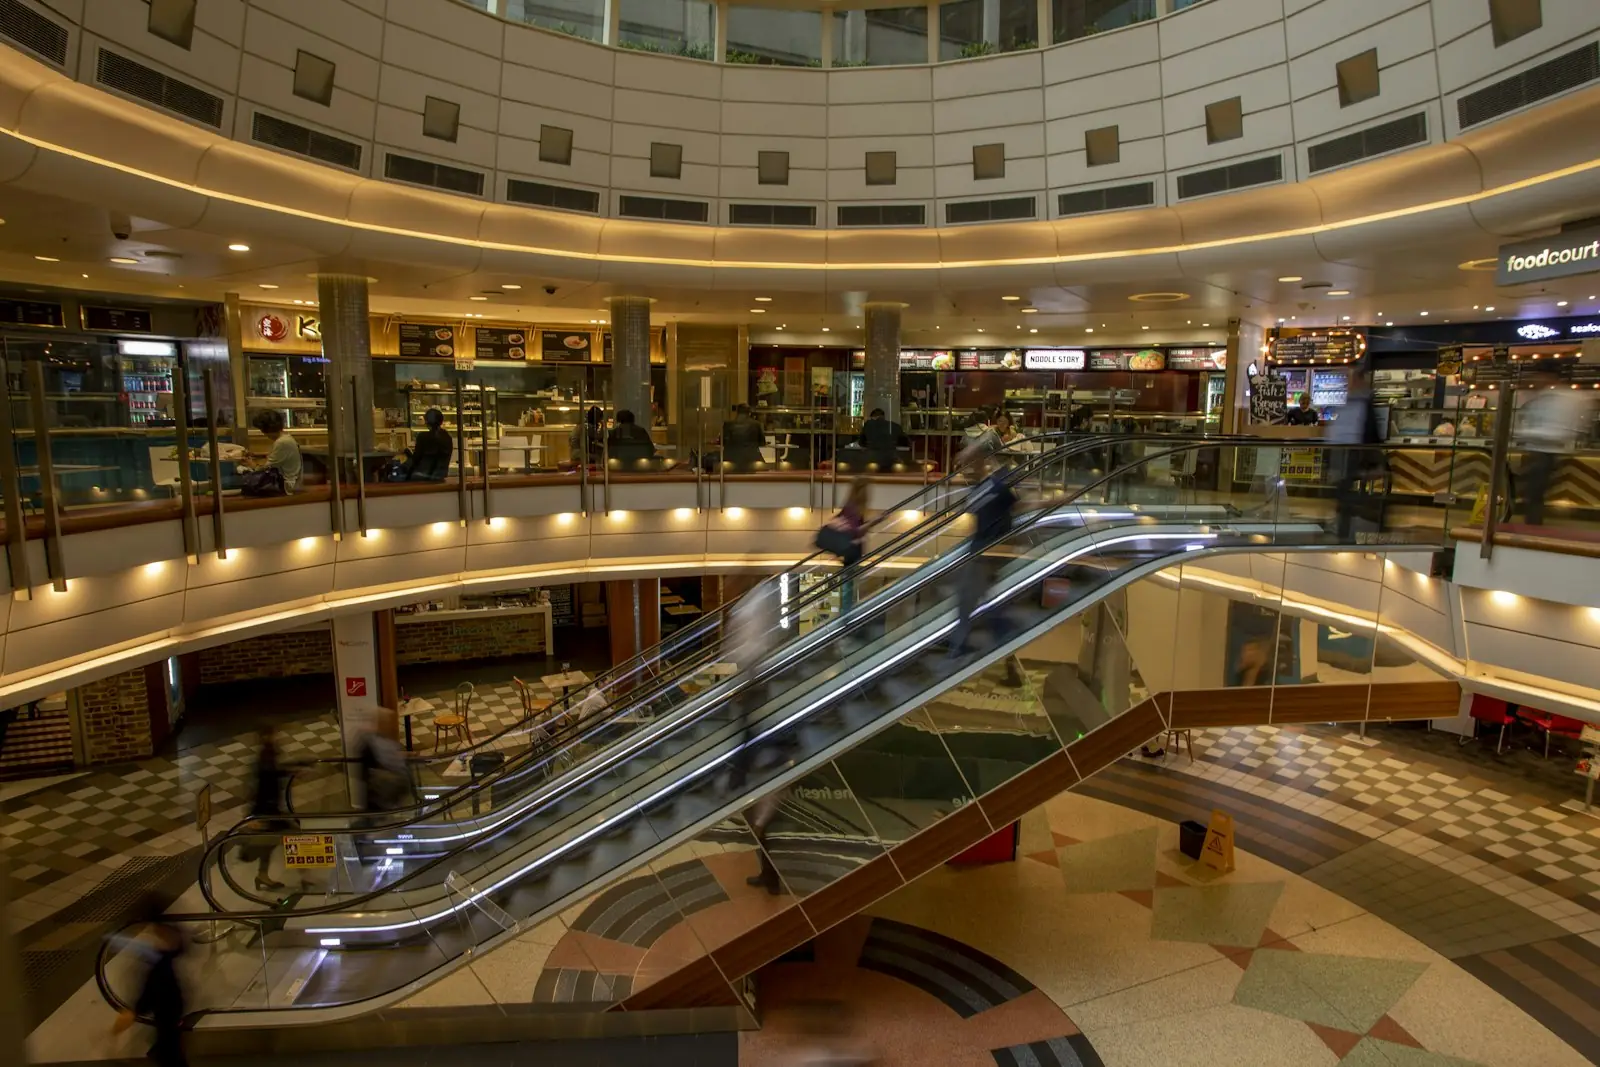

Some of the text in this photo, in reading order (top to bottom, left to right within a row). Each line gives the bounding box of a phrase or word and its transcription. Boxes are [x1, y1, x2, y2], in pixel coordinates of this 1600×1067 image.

[1507, 240, 1600, 272] foodcourt
[1030, 355, 1080, 363] NOODLE STORY
